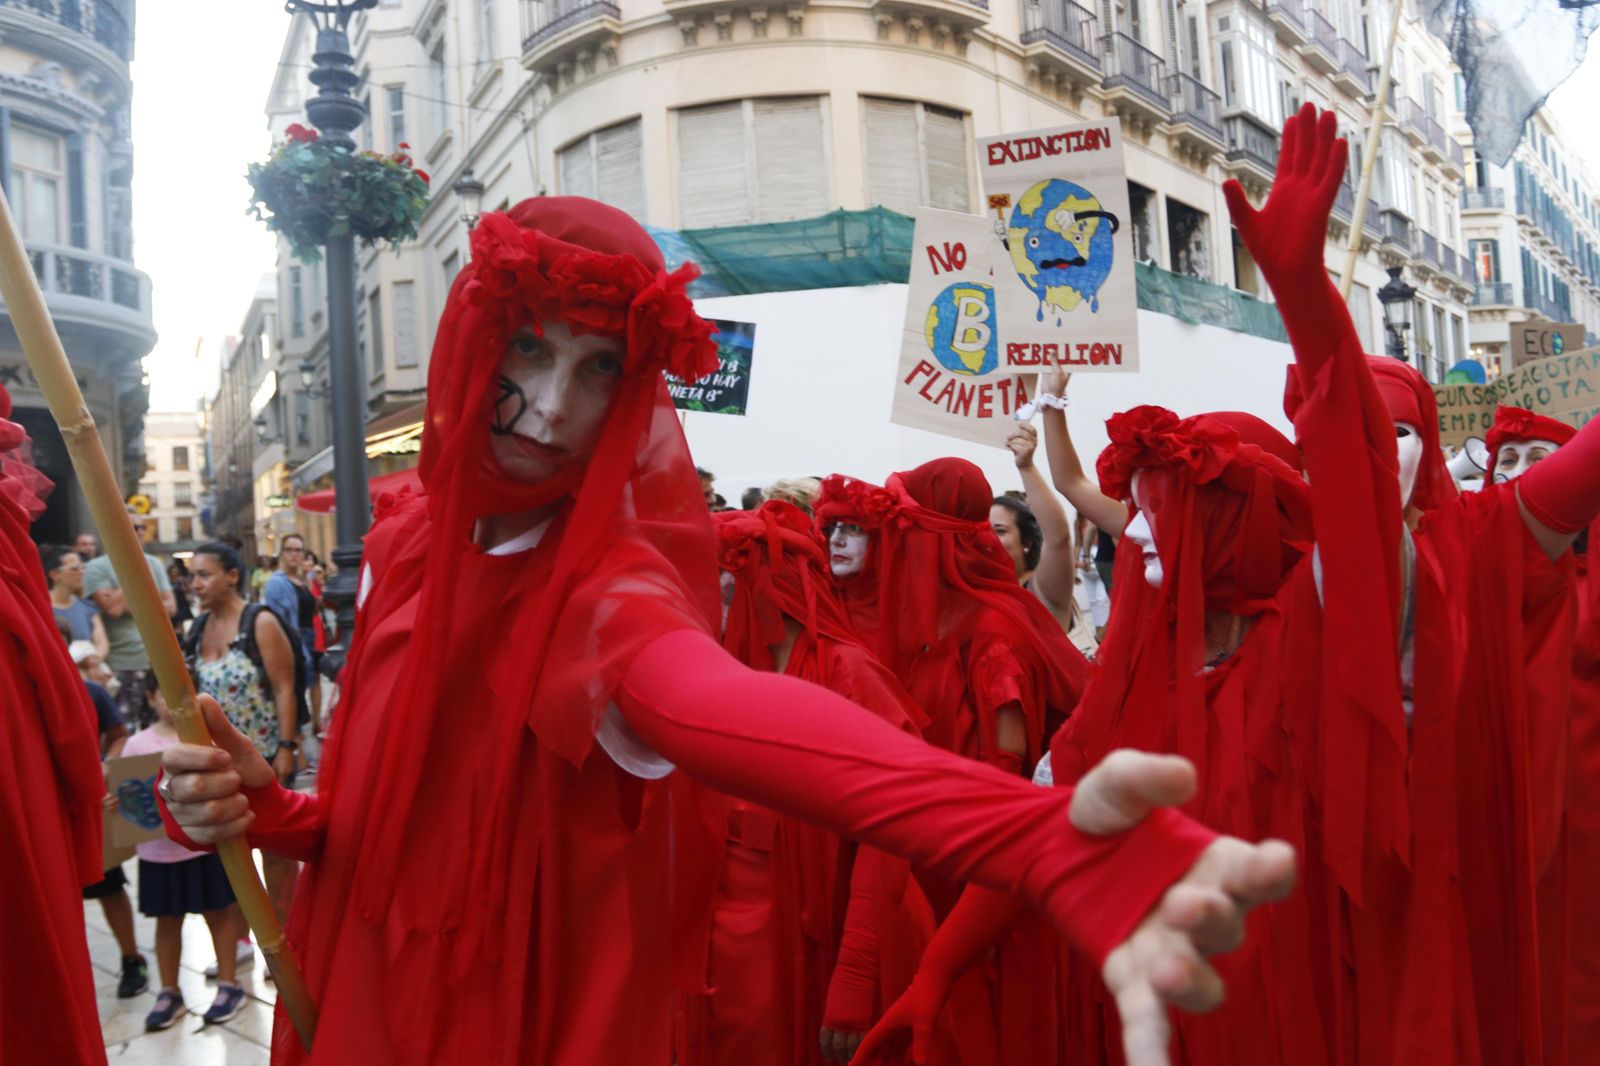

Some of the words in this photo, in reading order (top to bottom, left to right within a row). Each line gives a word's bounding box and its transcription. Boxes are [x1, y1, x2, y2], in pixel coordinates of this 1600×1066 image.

[987, 127, 1111, 165] EXTINCTION
[926, 242, 966, 276] NO
[951, 296, 992, 352] B
[727, 359, 739, 372] B
[1007, 343, 1122, 366] REBELLION
[712, 373, 741, 388] HAY
[904, 360, 1029, 418] PLANETA
